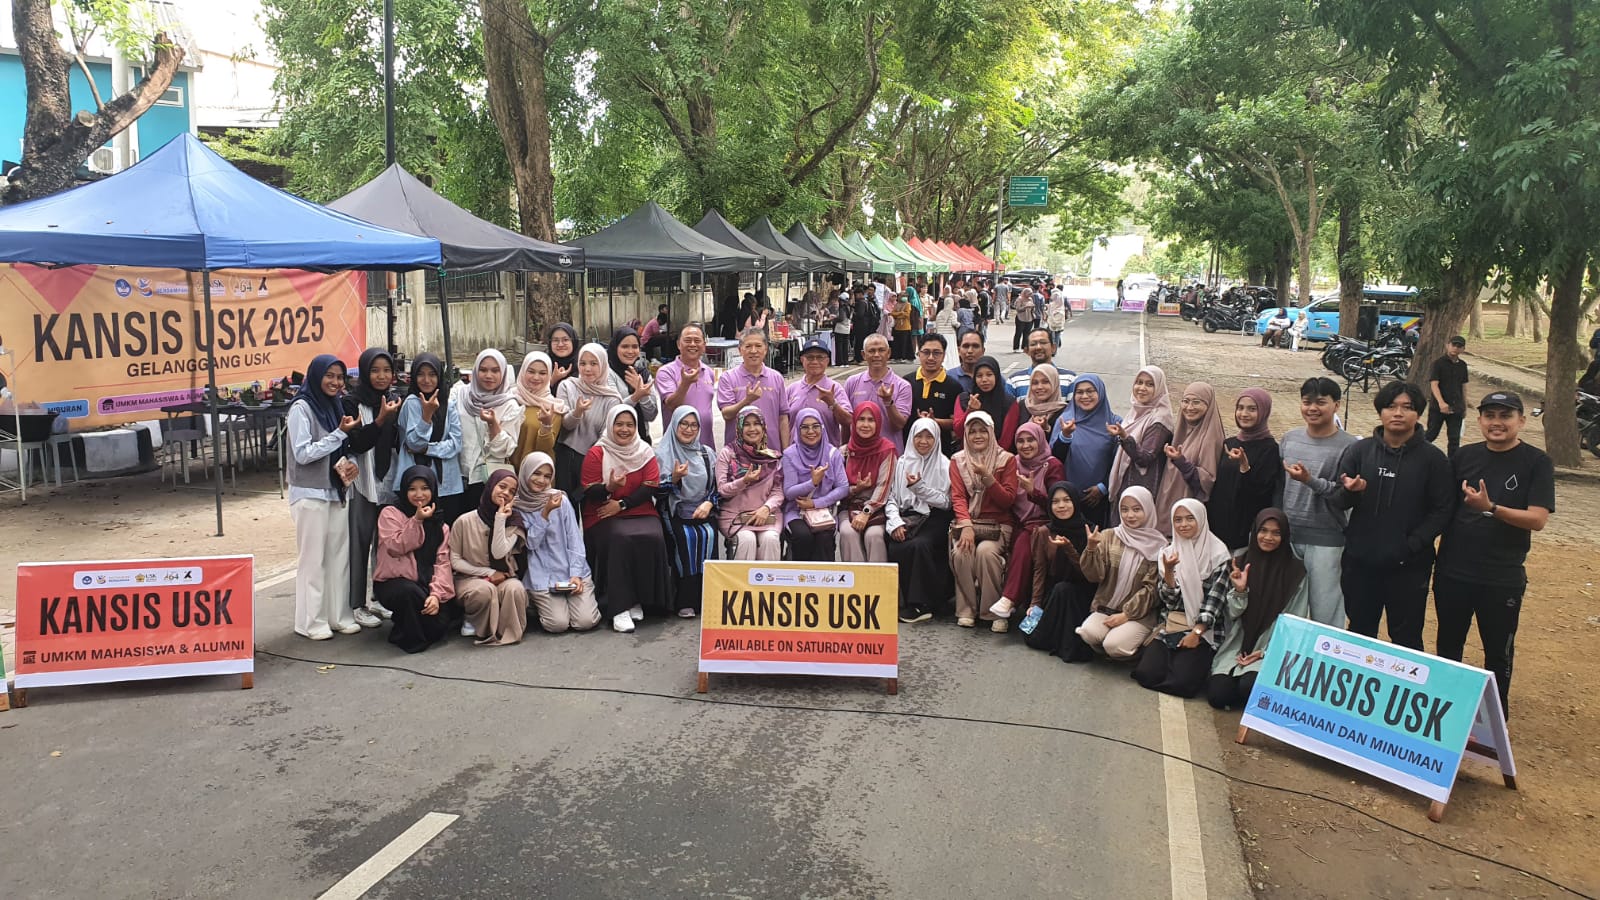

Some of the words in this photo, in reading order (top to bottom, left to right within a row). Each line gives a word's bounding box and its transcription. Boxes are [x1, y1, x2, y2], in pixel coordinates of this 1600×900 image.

[33, 310, 183, 363] KANSIS
[194, 308, 257, 352] USK
[264, 306, 325, 347] 2025
[126, 355, 241, 378] GELANGGANG
[243, 353, 272, 367] USK
[115, 399, 138, 408] UMKM
[138, 395, 179, 406] MAHASISWA
[39, 592, 161, 636] KANSIS
[172, 588, 233, 628] USK
[721, 590, 819, 629] KANSIS
[828, 593, 881, 630] USK
[41, 650, 87, 664] UMKM
[90, 644, 176, 660] MAHASISWA
[179, 643, 189, 654] &
[193, 640, 245, 653] ALUMNI
[714, 638, 775, 652] AVAILABLE
[778, 640, 794, 652] ON
[796, 641, 854, 655] SATURDAY
[856, 643, 885, 656] ONLY
[1274, 650, 1381, 718] KANSIS
[1383, 684, 1453, 742] USK
[1271, 702, 1336, 736] MAKANAN
[1337, 725, 1368, 747] DAN
[1368, 736, 1444, 775] MINUMAN
